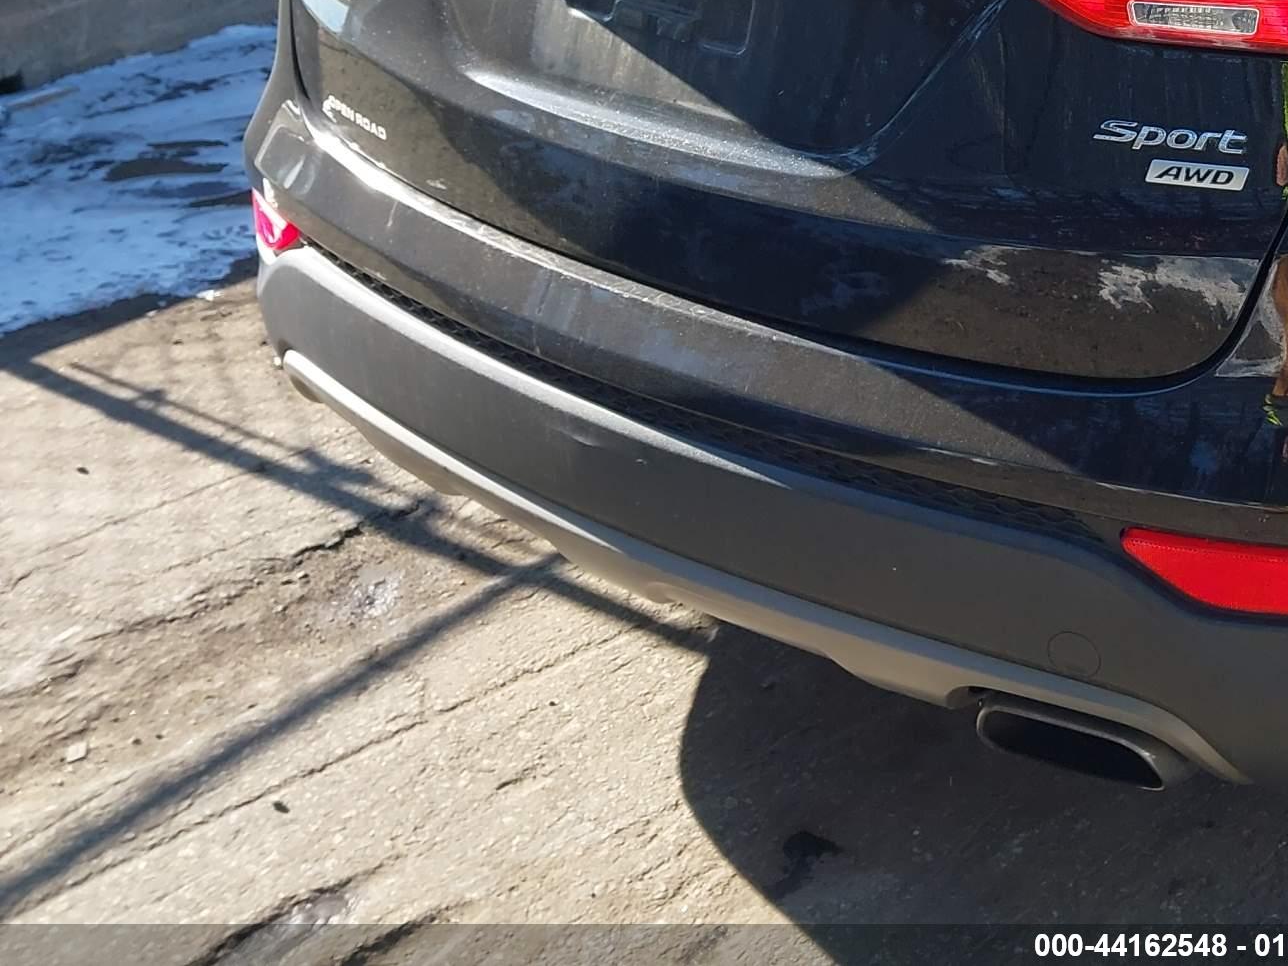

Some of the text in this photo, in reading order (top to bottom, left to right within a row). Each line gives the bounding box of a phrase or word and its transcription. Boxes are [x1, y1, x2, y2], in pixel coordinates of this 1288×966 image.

[355, 112, 387, 141] ROAD
[1093, 119, 1248, 154] Sport
[1154, 165, 1235, 186] AWD
